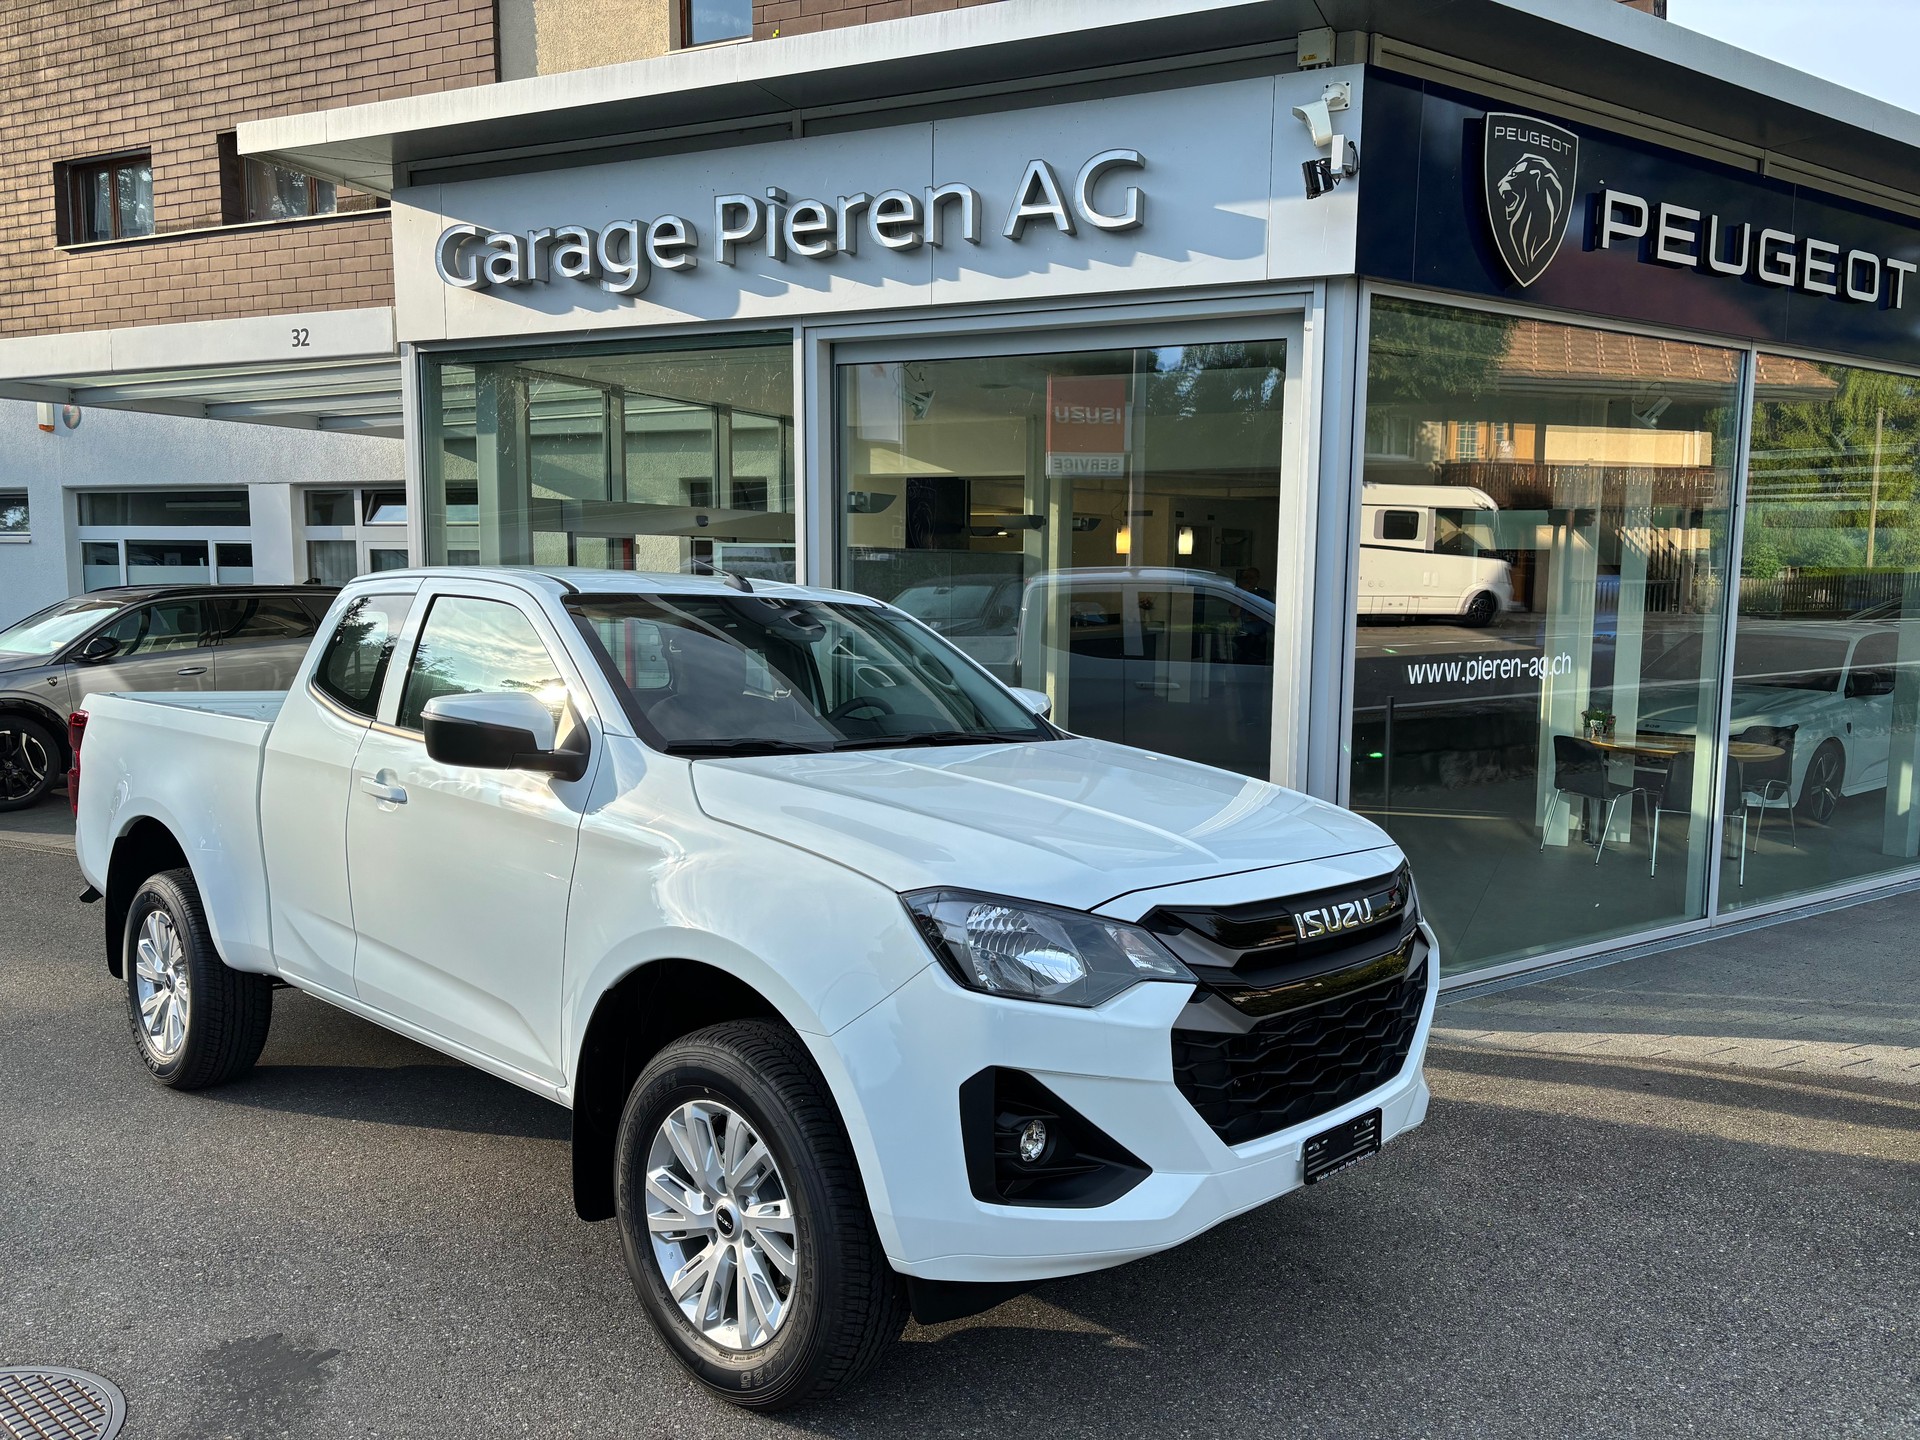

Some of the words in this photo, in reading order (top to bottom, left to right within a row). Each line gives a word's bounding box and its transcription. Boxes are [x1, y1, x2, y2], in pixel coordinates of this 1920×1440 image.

[1495, 126, 1571, 155] PEUGEOT
[434, 213, 698, 295] Garage
[714, 181, 981, 265] Pieren
[1002, 148, 1145, 241] AG
[1602, 189, 1917, 309] PEUGEOT
[291, 328, 310, 347] 32
[1407, 652, 1572, 685] www.pieren-ag.ch
[1294, 898, 1374, 939] ISUZU
